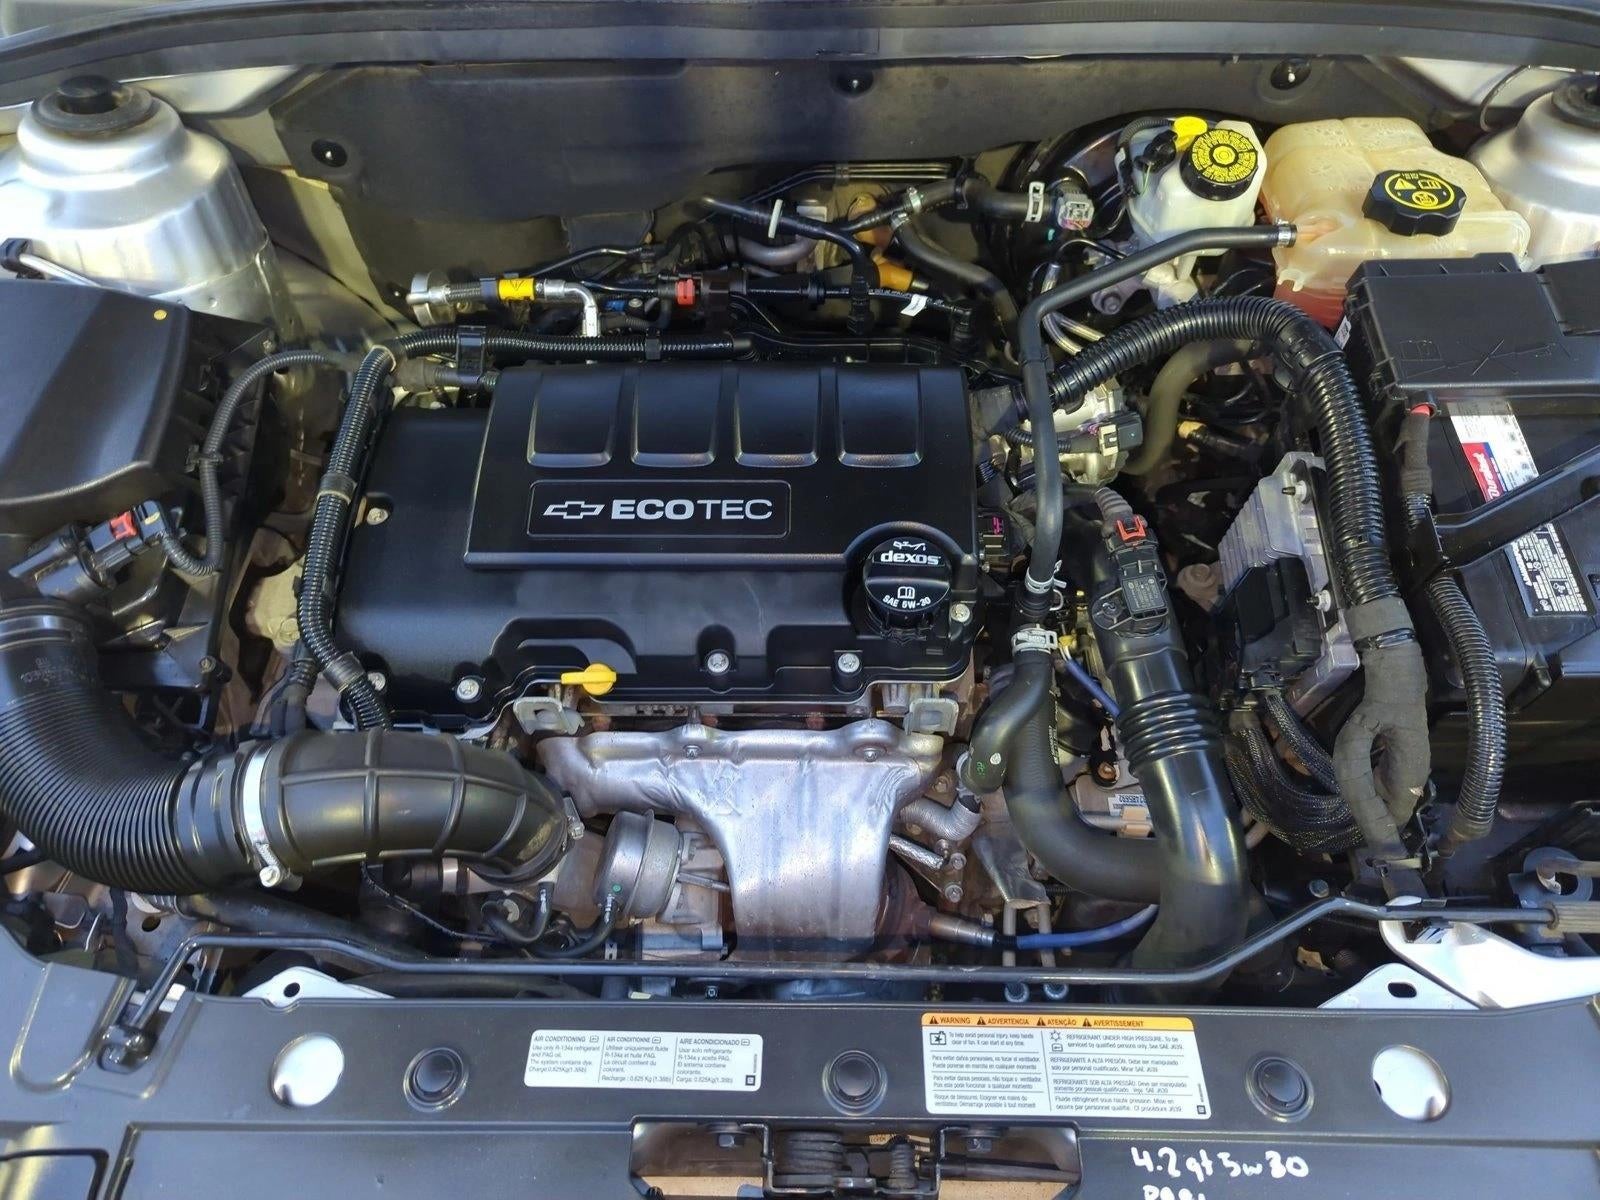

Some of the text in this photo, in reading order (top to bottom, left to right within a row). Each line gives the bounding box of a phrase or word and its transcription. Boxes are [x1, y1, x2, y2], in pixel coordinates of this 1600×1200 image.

[612, 499, 772, 520] ECOTEC
[881, 550, 939, 565] dexos
[883, 595, 931, 609] SAE 5W-30
[1131, 1147, 1181, 1177] 4.2
